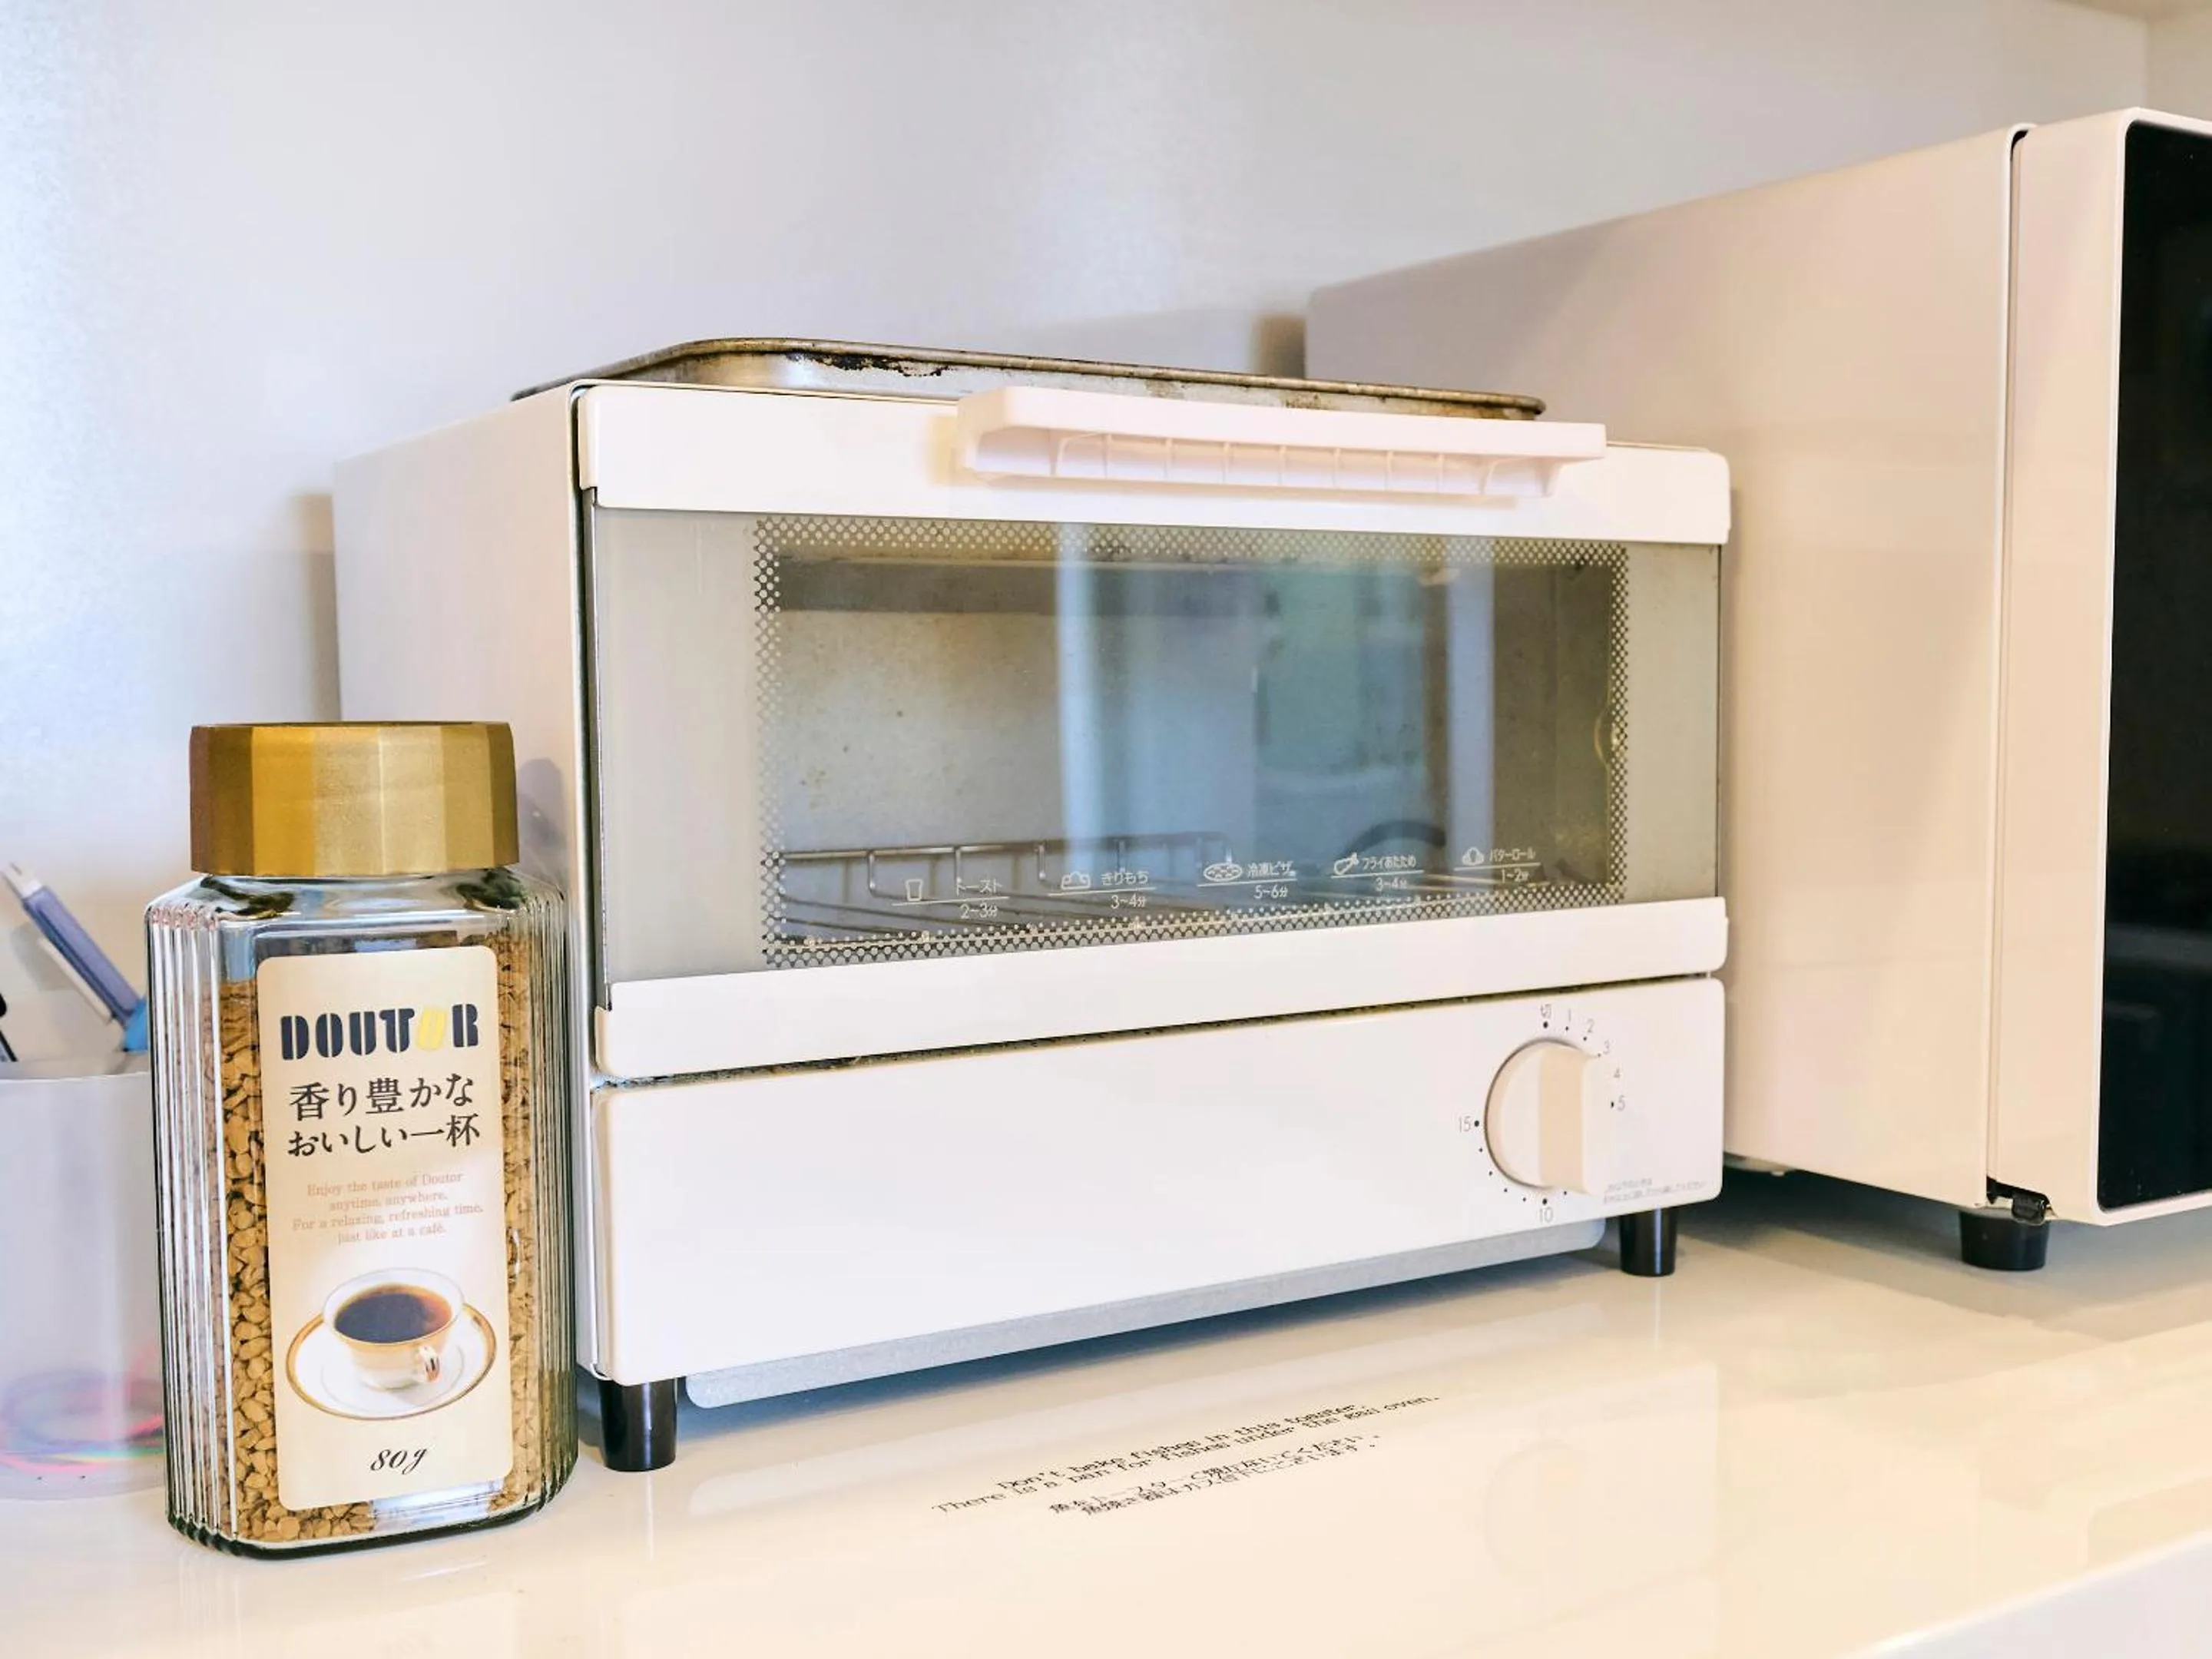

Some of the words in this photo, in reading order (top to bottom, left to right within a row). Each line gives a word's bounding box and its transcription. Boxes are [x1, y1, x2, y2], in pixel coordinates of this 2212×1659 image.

[1101, 869, 1149, 886] きりもち
[1247, 860, 1294, 877] 冷凍ピザ
[955, 877, 1003, 896] トースト
[281, 1003, 479, 1061] DOUTOR
[1586, 1018, 1595, 1033] 2
[1602, 1039, 1610, 1055] 3
[1614, 1067, 1621, 1078] 4
[289, 1073, 474, 1121] 香り豊かな
[1617, 1094, 1626, 1111] 5
[287, 1113, 480, 1157] おいしい一杯
[1459, 1117, 1472, 1134] 15
[307, 1183, 342, 1196] Enjoy
[347, 1181, 366, 1193] the
[372, 1179, 401, 1191] taste
[406, 1175, 419, 1187] of
[422, 1173, 463, 1186] Doutor
[293, 1218, 316, 1230] For
[320, 1220, 327, 1230] a
[389, 1207, 450, 1223] refreshing
[1538, 1207, 1554, 1224] 10
[338, 1231, 360, 1247] just
[366, 1229, 387, 1241] like
[391, 1227, 403, 1239] at
[408, 1228, 416, 1237] a
[369, 1446, 428, 1475] 80g
[931, 1492, 1006, 1514] There
[1067, 1469, 1111, 1483] pan
[1117, 1458, 1151, 1471] for
[1159, 1441, 1230, 1461] fishes
[1234, 1426, 1296, 1445] under
[1302, 1416, 1341, 1429] the
[995, 1469, 1065, 1490] Don't
[1068, 1456, 1125, 1473] bake
[1130, 1439, 1201, 1459] fishes
[1204, 1432, 1230, 1442] in
[1234, 1421, 1281, 1436] this
